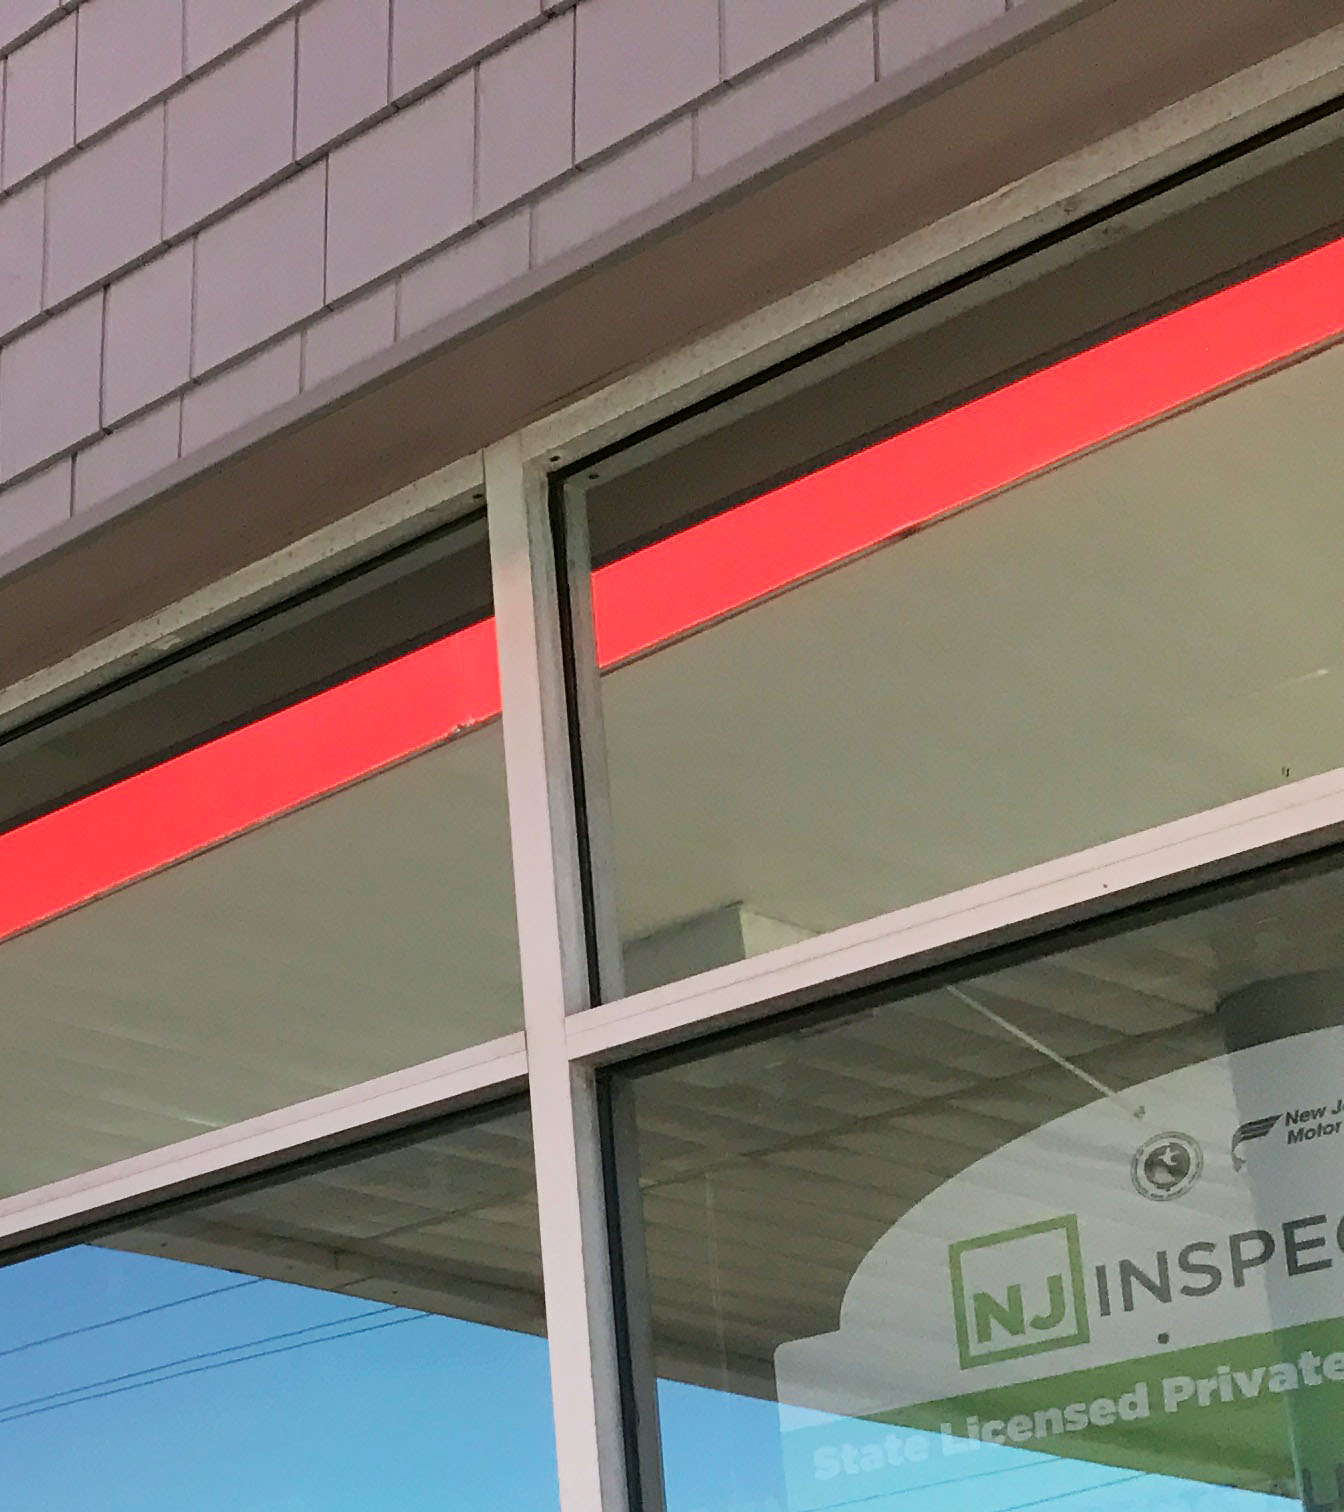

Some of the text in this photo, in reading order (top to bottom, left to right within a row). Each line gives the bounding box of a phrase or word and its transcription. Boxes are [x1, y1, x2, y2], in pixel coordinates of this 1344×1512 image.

[1285, 1106, 1327, 1126] New
[1287, 1121, 1342, 1144] Motor
[971, 1214, 1344, 1345] NJ INSPE
[813, 1431, 929, 1481] State
[941, 1382, 1150, 1458] Licensed
